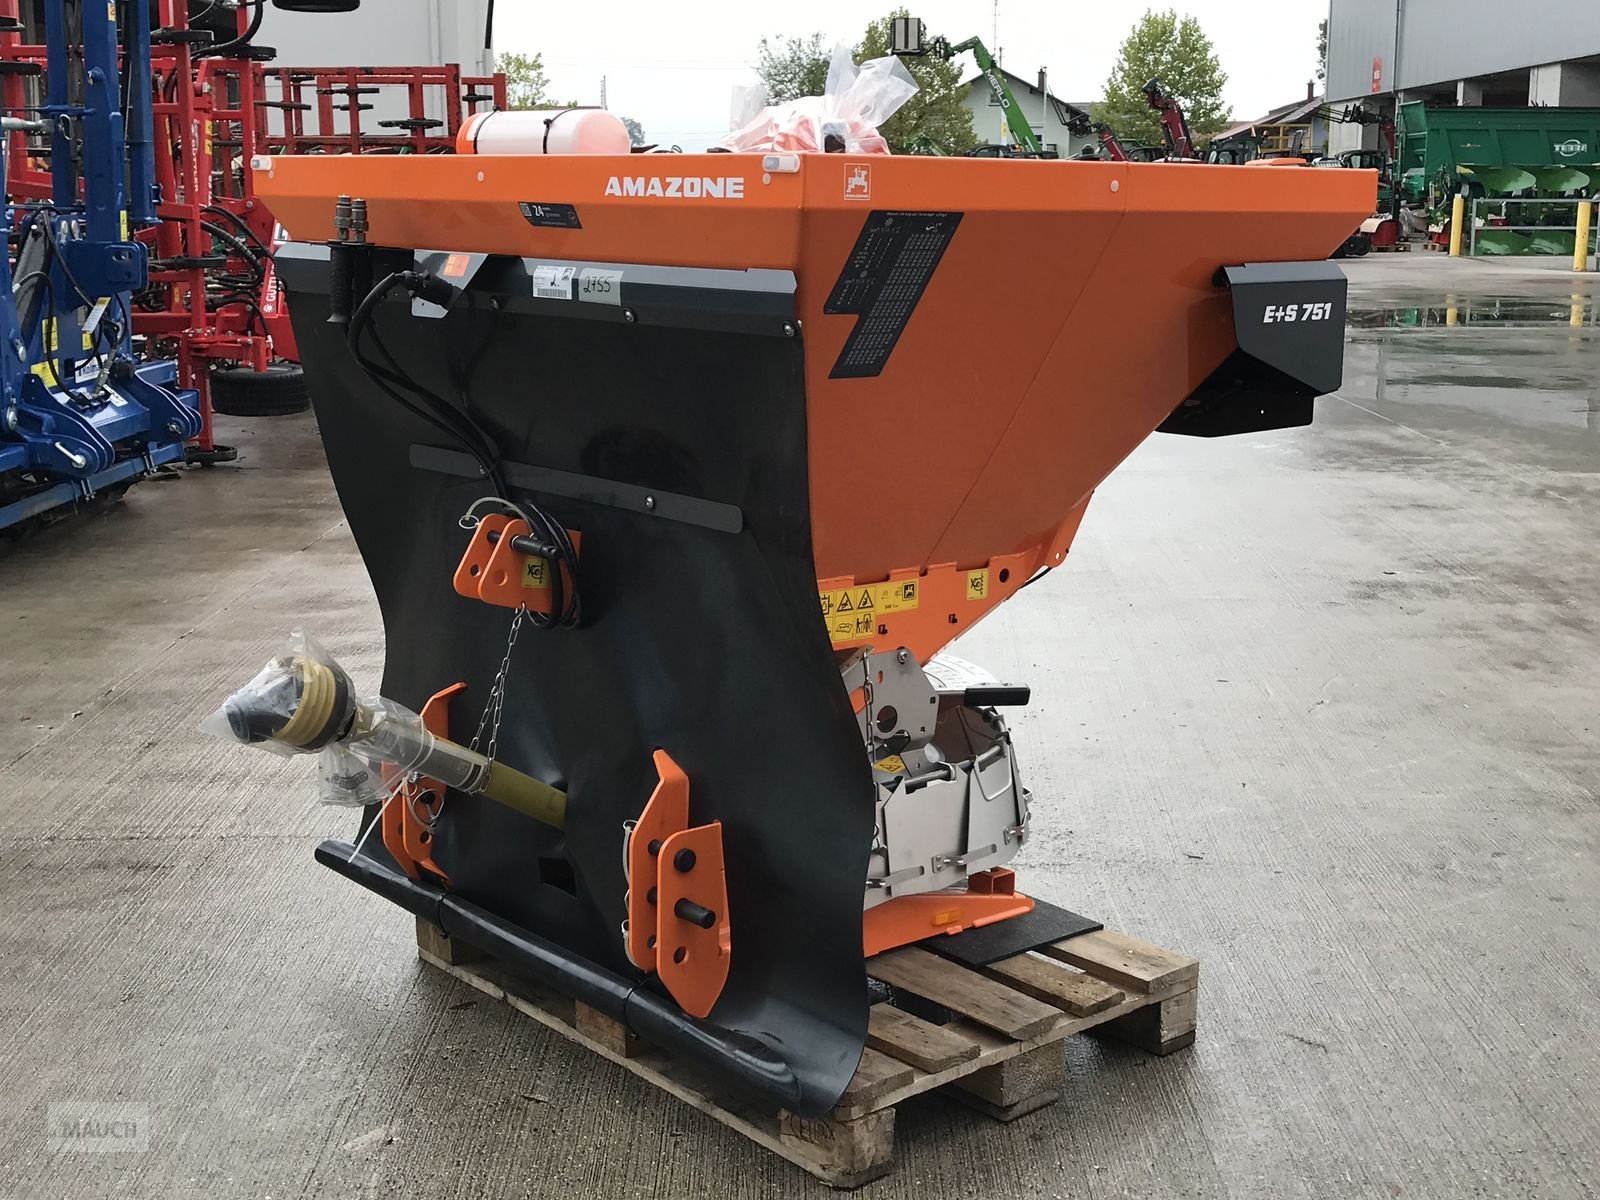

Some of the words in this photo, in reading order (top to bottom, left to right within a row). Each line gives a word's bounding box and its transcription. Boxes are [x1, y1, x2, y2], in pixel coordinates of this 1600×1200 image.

[985, 69, 1010, 109] MERLO
[604, 176, 744, 198] AMAZONE
[532, 205, 545, 217] 24
[583, 275, 615, 293] 2755
[1263, 304, 1299, 324] E+S
[1301, 302, 1332, 321] 751
